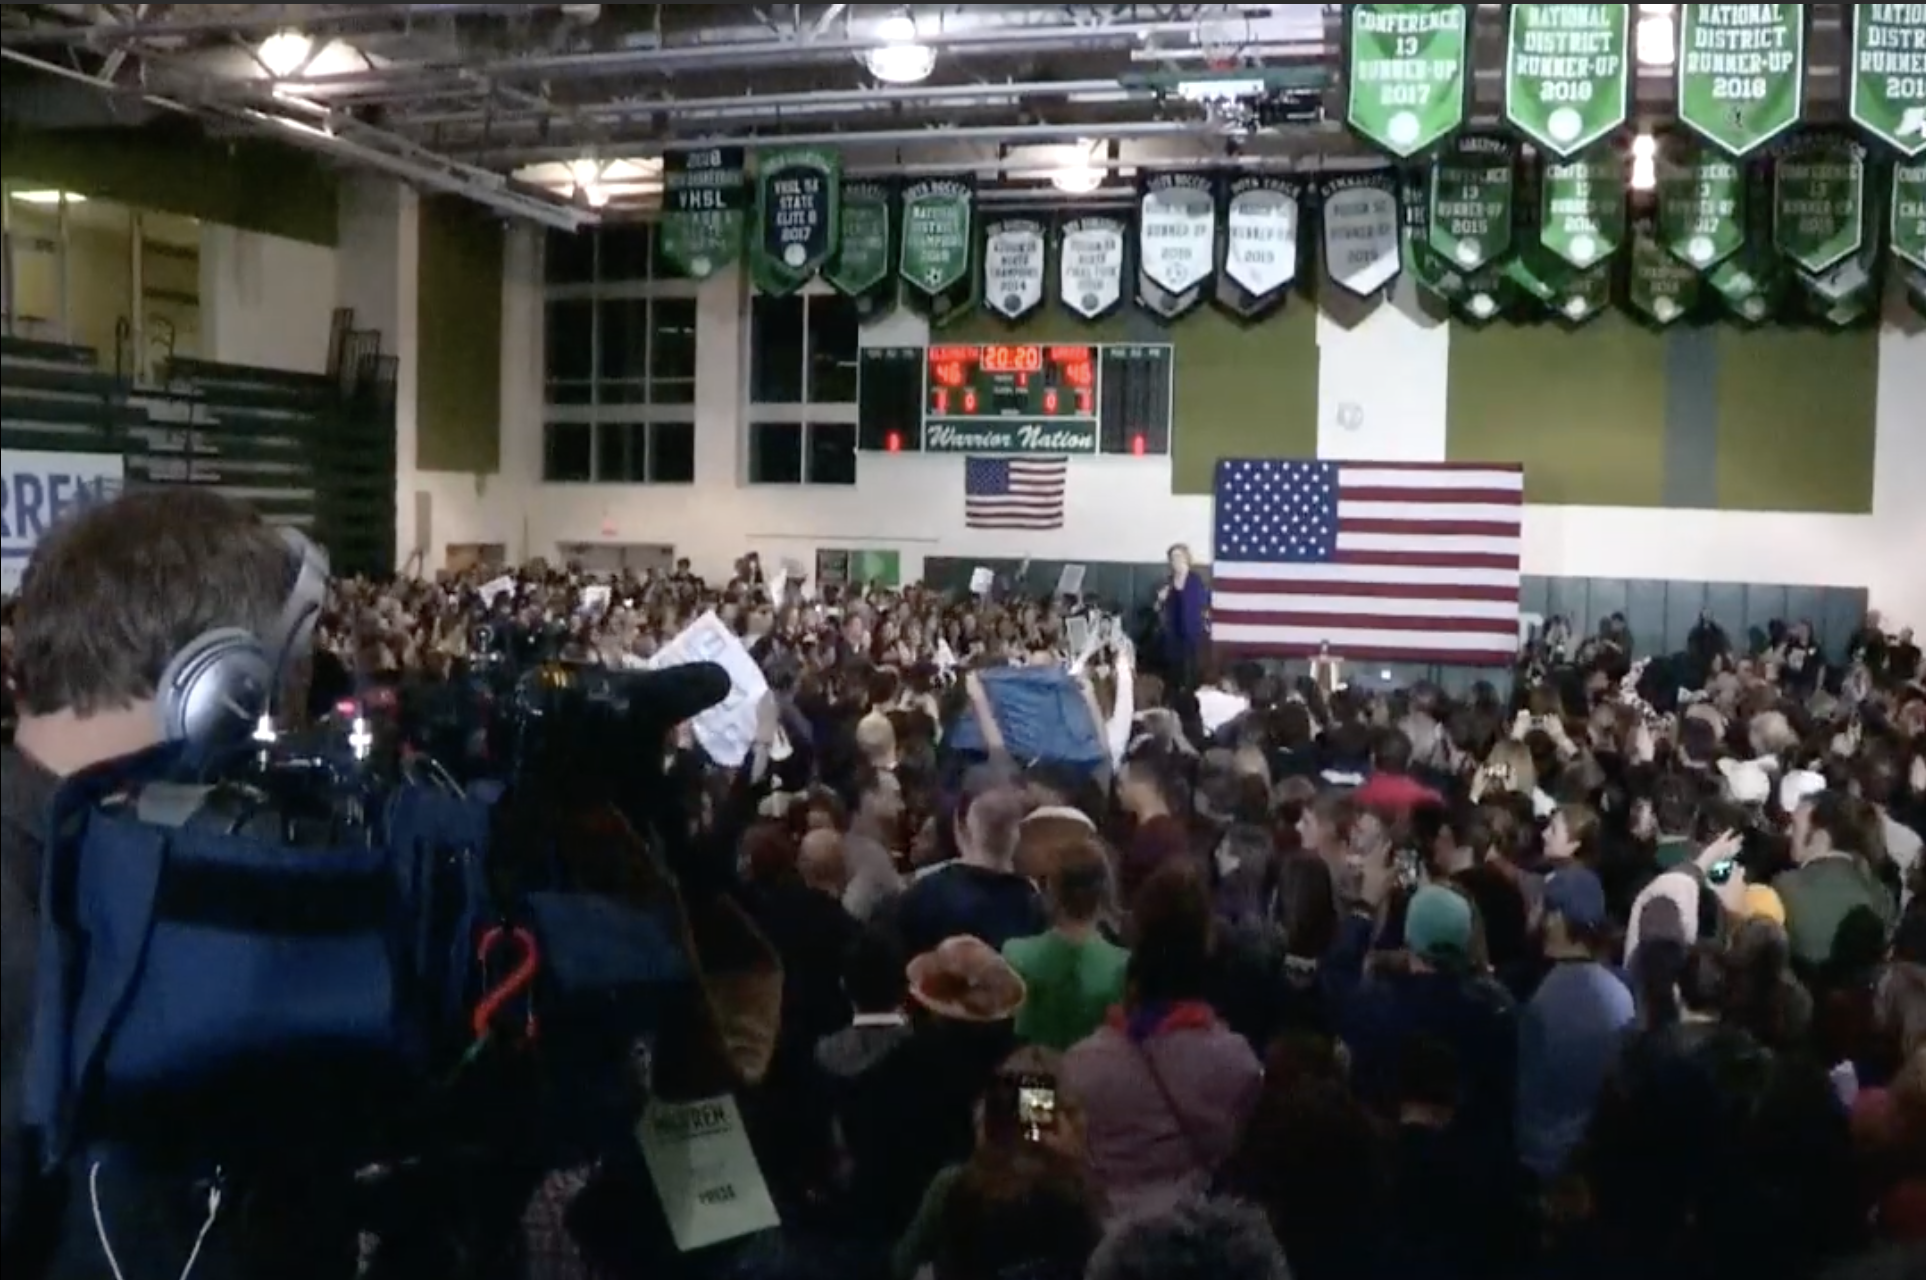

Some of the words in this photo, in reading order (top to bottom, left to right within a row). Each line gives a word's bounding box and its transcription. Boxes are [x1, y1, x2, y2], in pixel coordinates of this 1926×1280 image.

[1357, 9, 1460, 34] CONFERENCE
[1526, 5, 1611, 28] NATIONAL
[1698, 5, 1783, 26] NATIONAL
[1871, 5, 1926, 28] NATIO
[1395, 37, 1418, 57] 13
[1524, 30, 1614, 52] DISTRICT
[1694, 26, 1788, 49] DISTRICT
[1867, 26, 1926, 49] DISTR
[1357, 59, 1458, 82] RUNNER-UP
[1516, 54, 1619, 76] RUNNER-UP
[1687, 51, 1793, 74] RUNNER-UP
[1860, 51, 1926, 74] RUNNE
[1380, 83, 1431, 105] 2017
[1886, 77, 1926, 99] 201
[679, 189, 727, 209] VHSL
[779, 195, 815, 210] STATE
[984, 346, 1040, 369] 20:20
[936, 360, 962, 387] 46
[1066, 361, 1093, 386] 46
[964, 392, 976, 412] 0
[1046, 391, 1058, 412] 0
[927, 423, 1011, 448] Warrior
[1017, 424, 1094, 449] Nation
